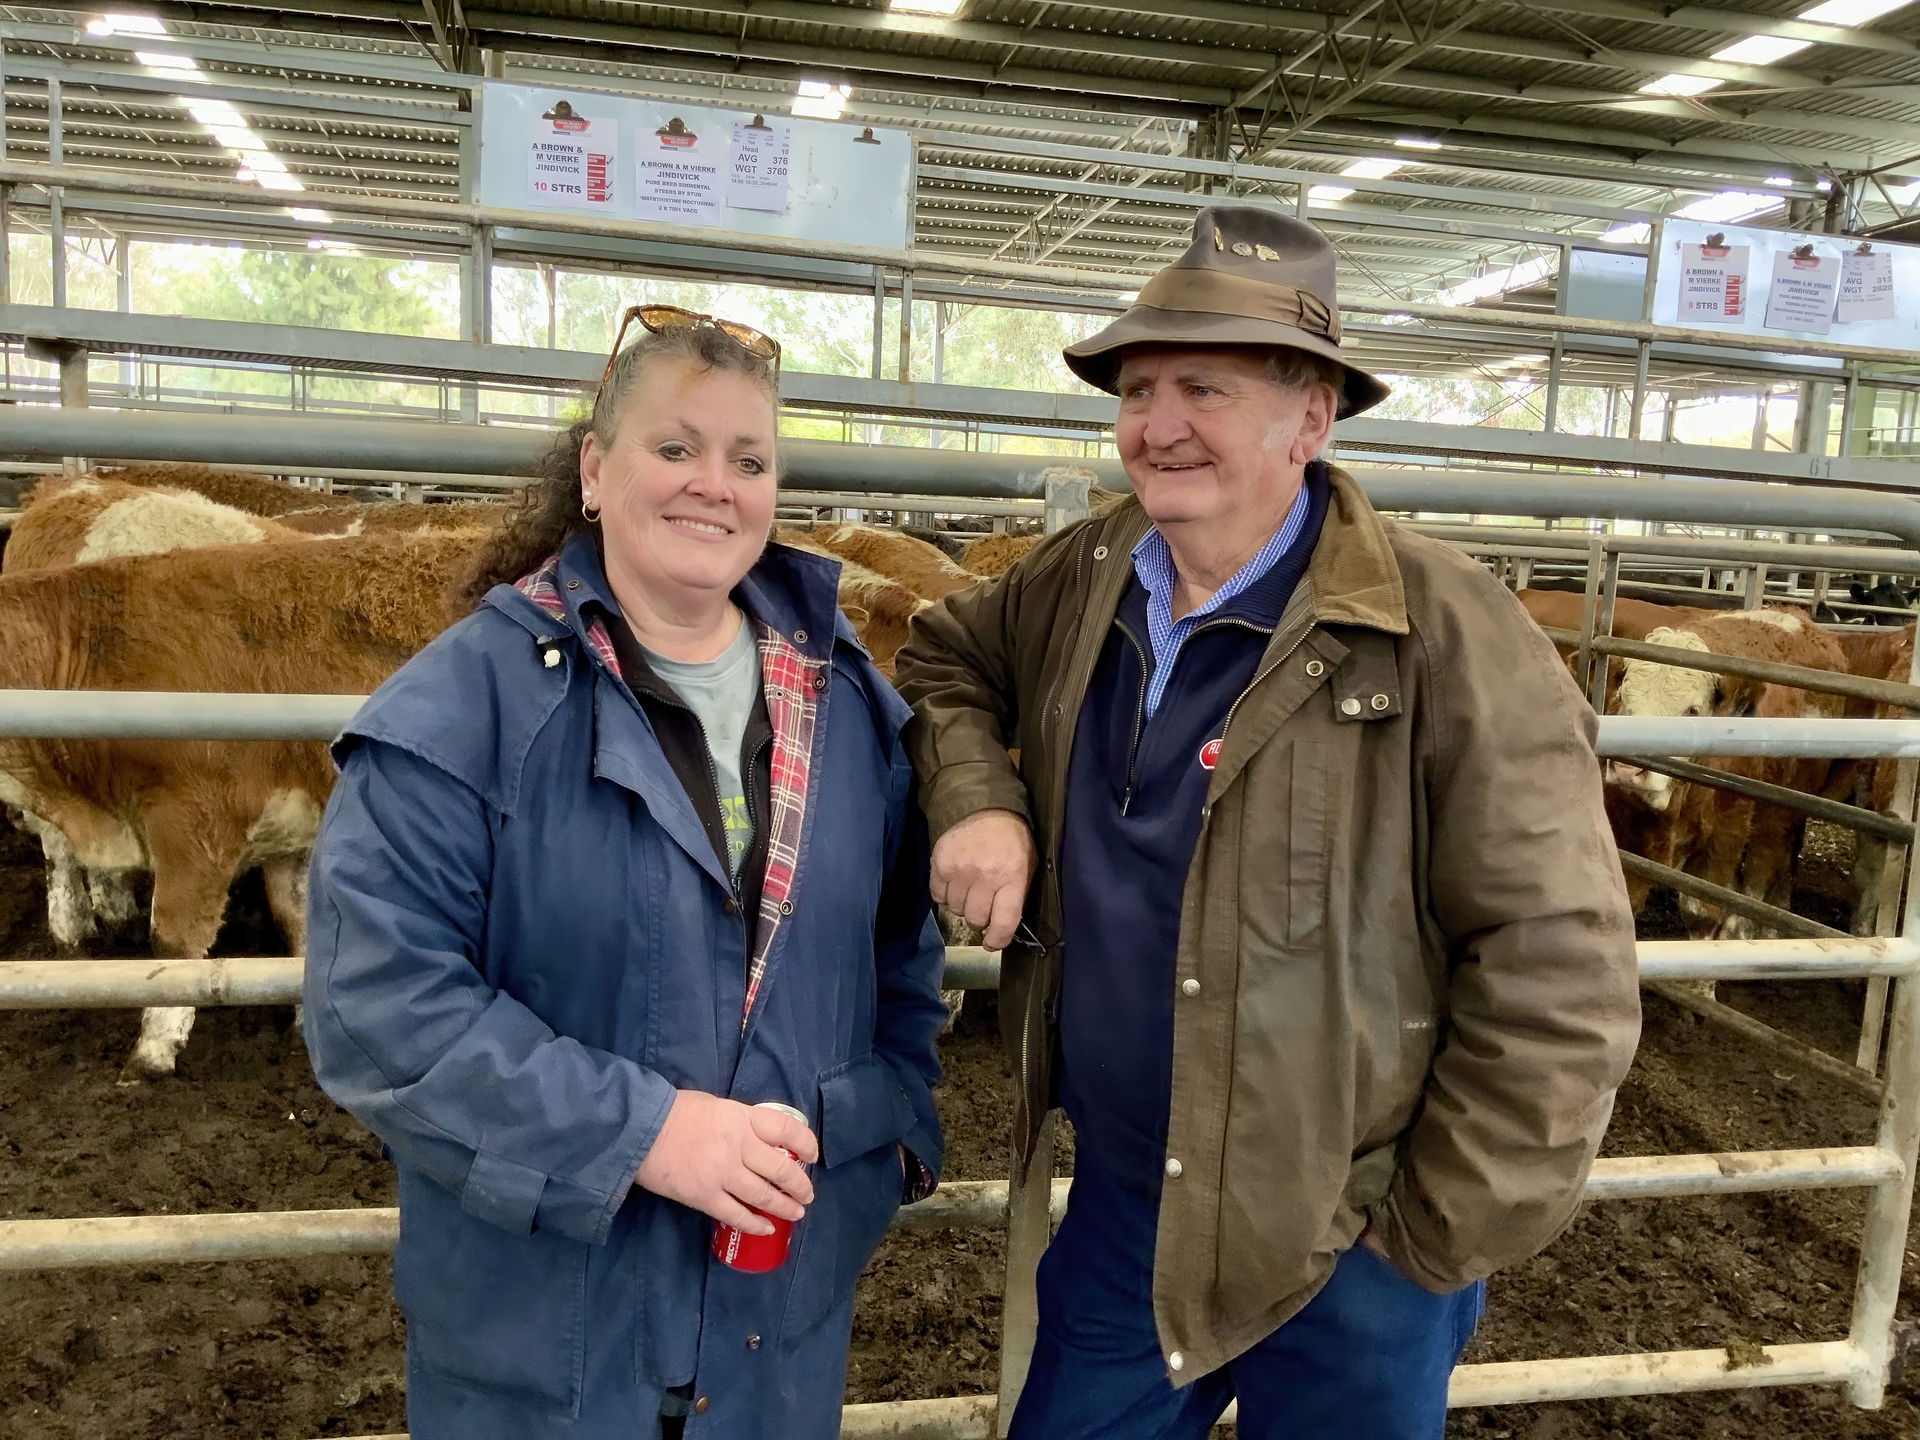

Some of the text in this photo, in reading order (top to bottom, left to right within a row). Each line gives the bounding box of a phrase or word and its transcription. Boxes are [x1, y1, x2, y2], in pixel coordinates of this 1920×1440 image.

[541, 143, 574, 153] BROWN
[536, 153, 543, 161] M
[547, 154, 579, 163] VIERKE
[738, 153, 788, 165] AVG 376
[536, 164, 580, 174] JINDIVICK
[648, 161, 673, 169] BROWN
[690, 165, 716, 173] VIERKE
[735, 164, 788, 176] WGT 3760
[657, 171, 700, 181] JINDIVICK
[534, 181, 547, 191] 10
[551, 183, 582, 194] STRS
[1846, 276, 1892, 285] AVG 313
[1688, 301, 1693, 309] 9
[1696, 302, 1718, 310] STRS
